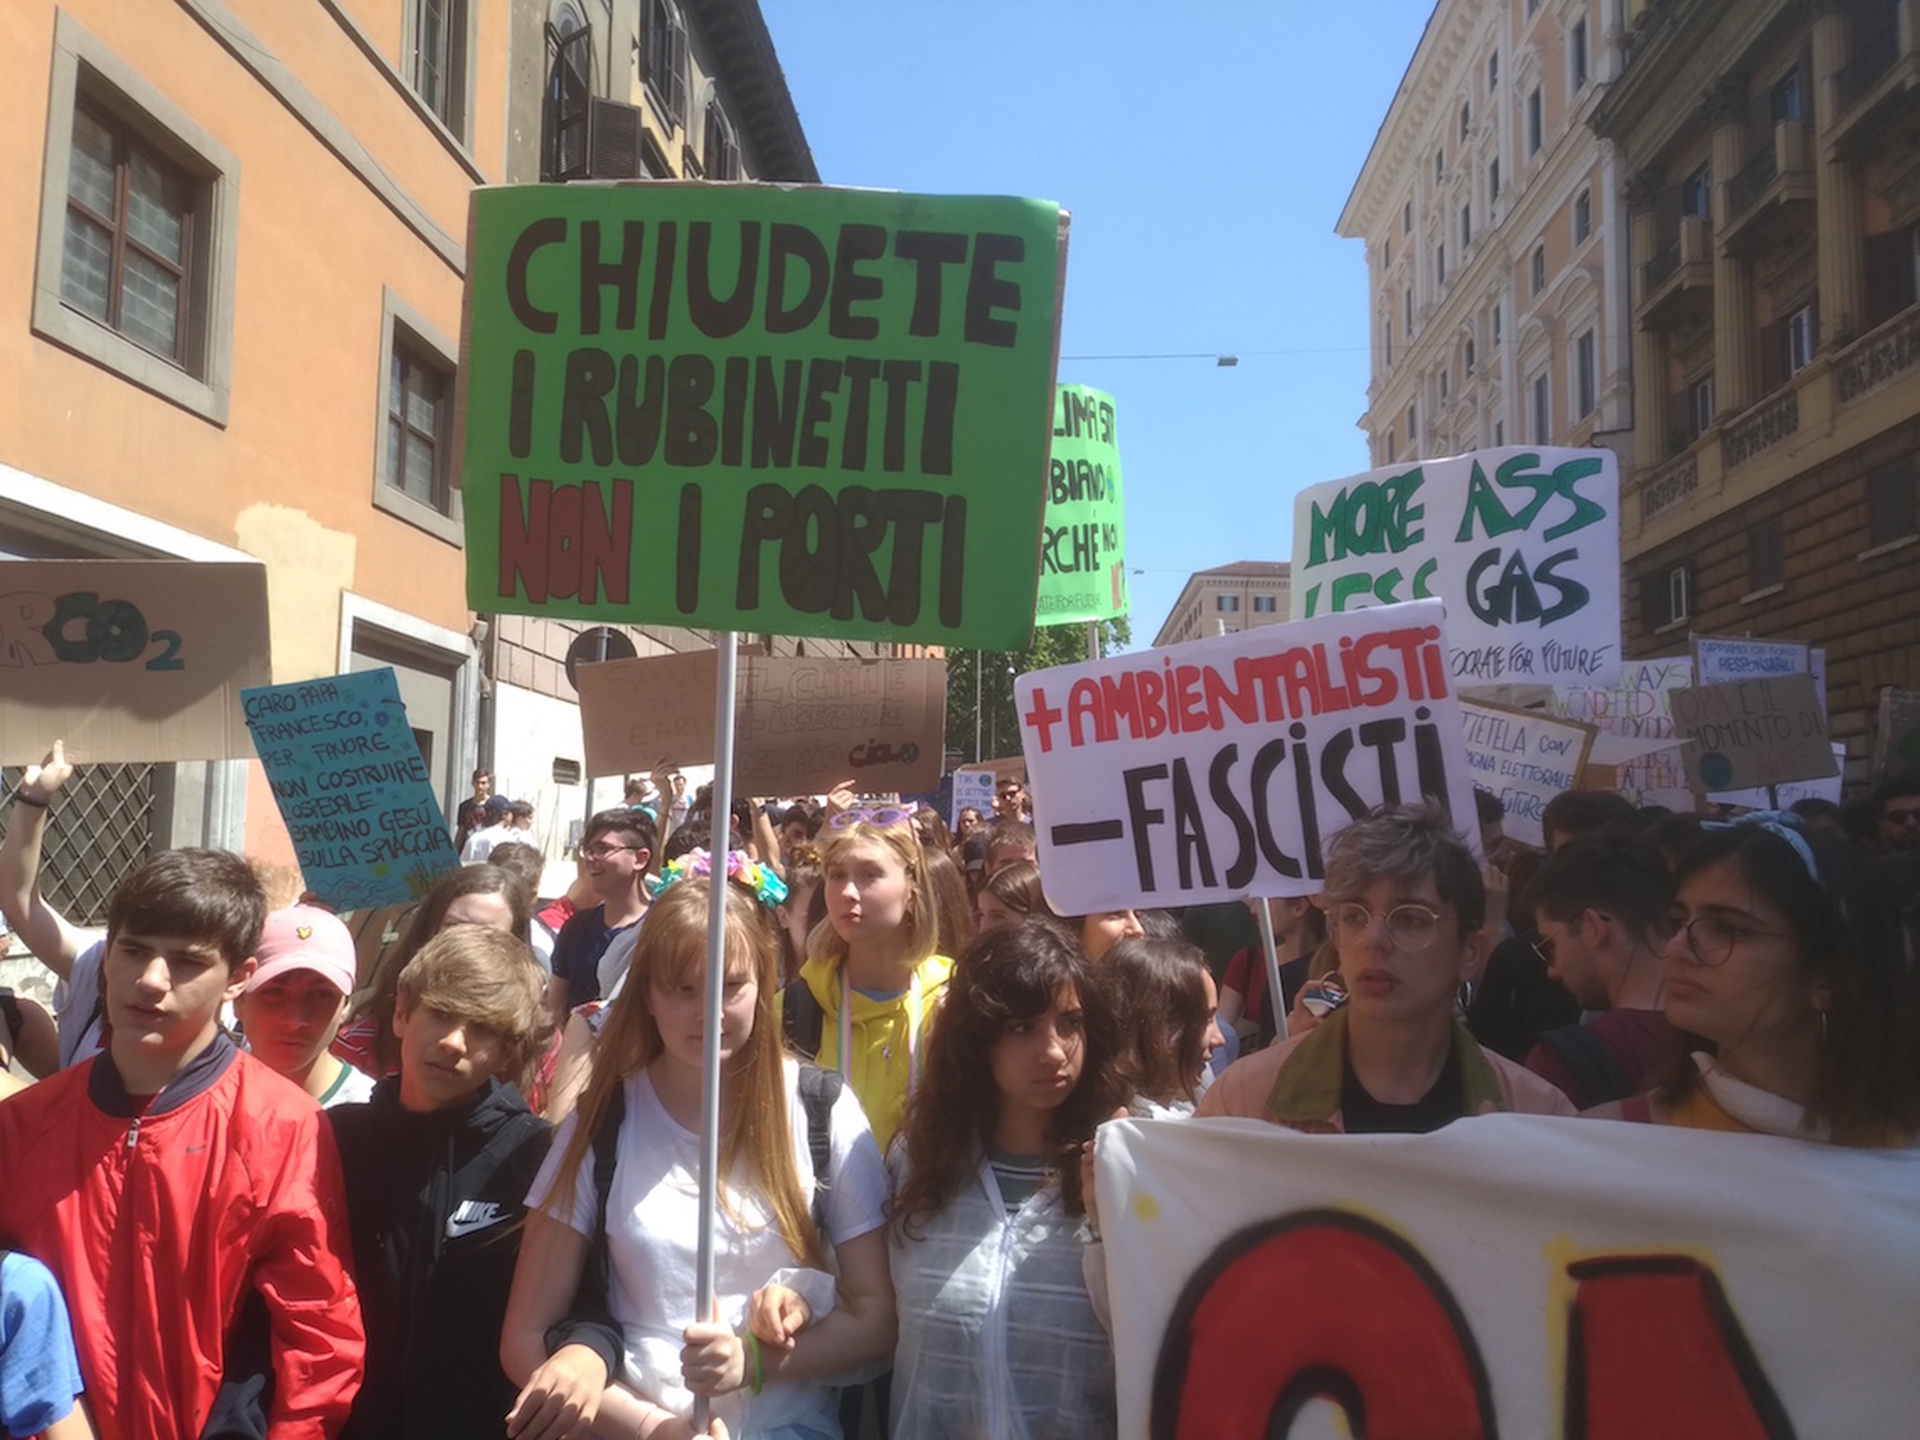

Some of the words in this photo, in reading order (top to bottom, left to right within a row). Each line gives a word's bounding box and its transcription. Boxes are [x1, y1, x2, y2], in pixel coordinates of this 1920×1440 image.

[506, 217, 1024, 348] CHIUDETE
[509, 349, 535, 459] I
[559, 347, 960, 476] RUBINETTI
[1304, 466, 1425, 570] MORE
[1454, 453, 1606, 543] ASS
[498, 473, 634, 604] NON
[675, 483, 703, 614] I
[735, 482, 967, 629] PORTI
[1466, 547, 1590, 628] GAS
[1451, 645, 1505, 680] OCRATE
[1508, 641, 1534, 675] FOR
[1542, 639, 1613, 676] FUTURE
[1718, 656, 1796, 673] RESPONSABILI
[245, 692, 296, 719] CARO
[263, 749, 297, 770] PER
[312, 732, 390, 764] FAVORE
[1686, 714, 1792, 754] MOMENTO
[1799, 711, 1822, 738] DI
[270, 779, 309, 799] NON
[317, 756, 431, 791] COSTRUIRE
[1500, 760, 1575, 789] ELETTORALE
[291, 818, 370, 844] BAMBINO
[301, 846, 358, 869] SULLA
[361, 826, 452, 864] SPIAGGIA
[453, 1199, 501, 1222] NIKE
